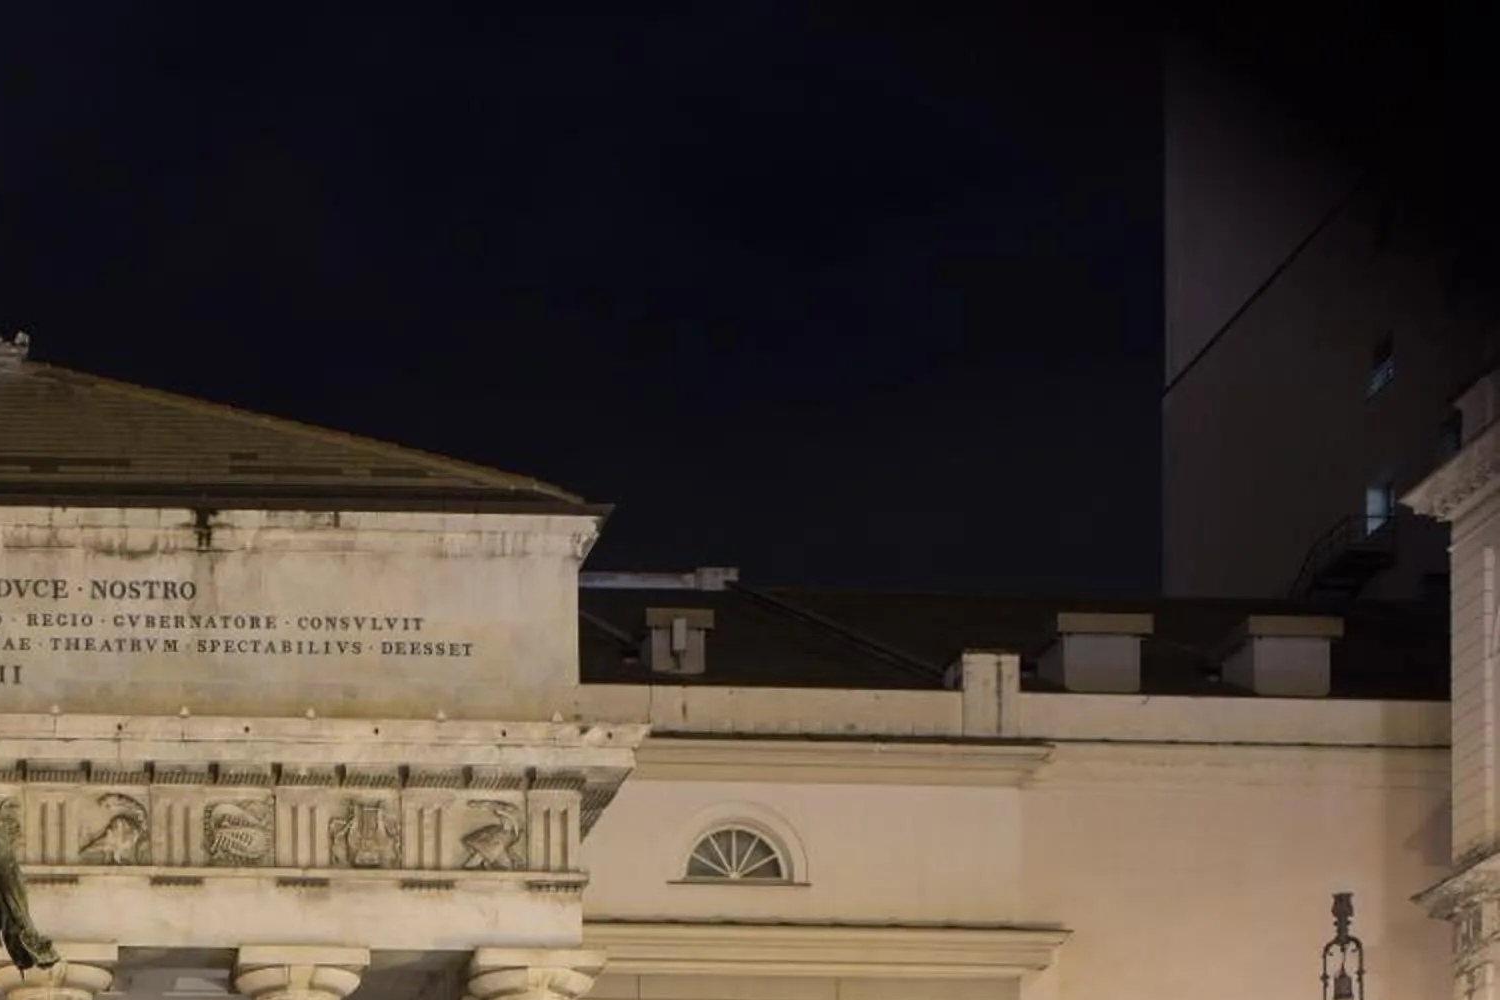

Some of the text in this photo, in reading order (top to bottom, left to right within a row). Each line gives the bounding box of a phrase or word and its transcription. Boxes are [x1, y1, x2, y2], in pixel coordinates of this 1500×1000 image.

[90, 580, 197, 601] NOSTRO
[26, 613, 94, 628] REGIO
[297, 616, 424, 632] CONSVLVIT
[50, 637, 180, 653] THEATRVM
[197, 639, 362, 656] SPECTABILIVS
[380, 641, 474, 657] DEESSET
